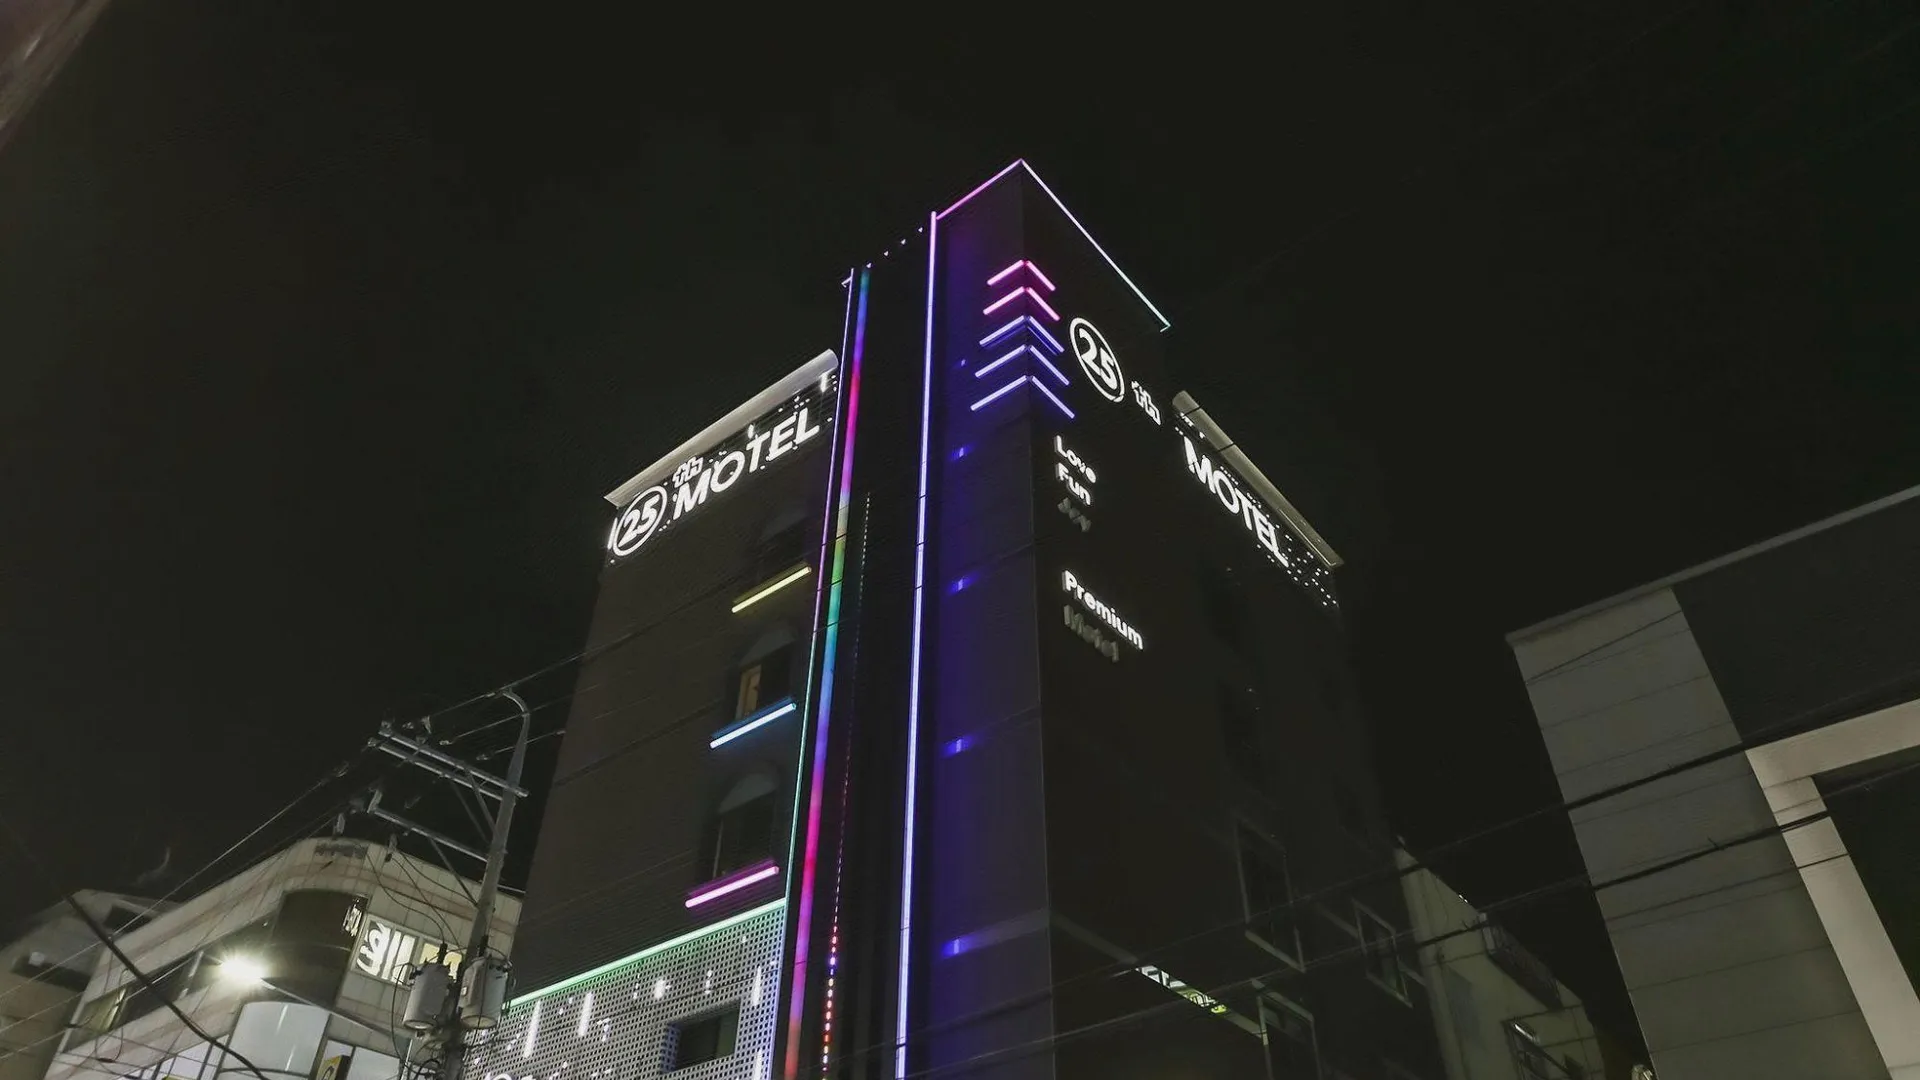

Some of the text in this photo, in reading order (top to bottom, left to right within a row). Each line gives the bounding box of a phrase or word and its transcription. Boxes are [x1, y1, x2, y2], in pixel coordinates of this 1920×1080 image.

[618, 493, 660, 548] 25
[673, 408, 820, 520] MOTEL
[1056, 434, 1097, 483] Love
[1058, 462, 1091, 505] Fun
[1079, 327, 1118, 391] 25
[1184, 435, 1289, 568] MOTEL
[1063, 570, 1144, 650] Premium
